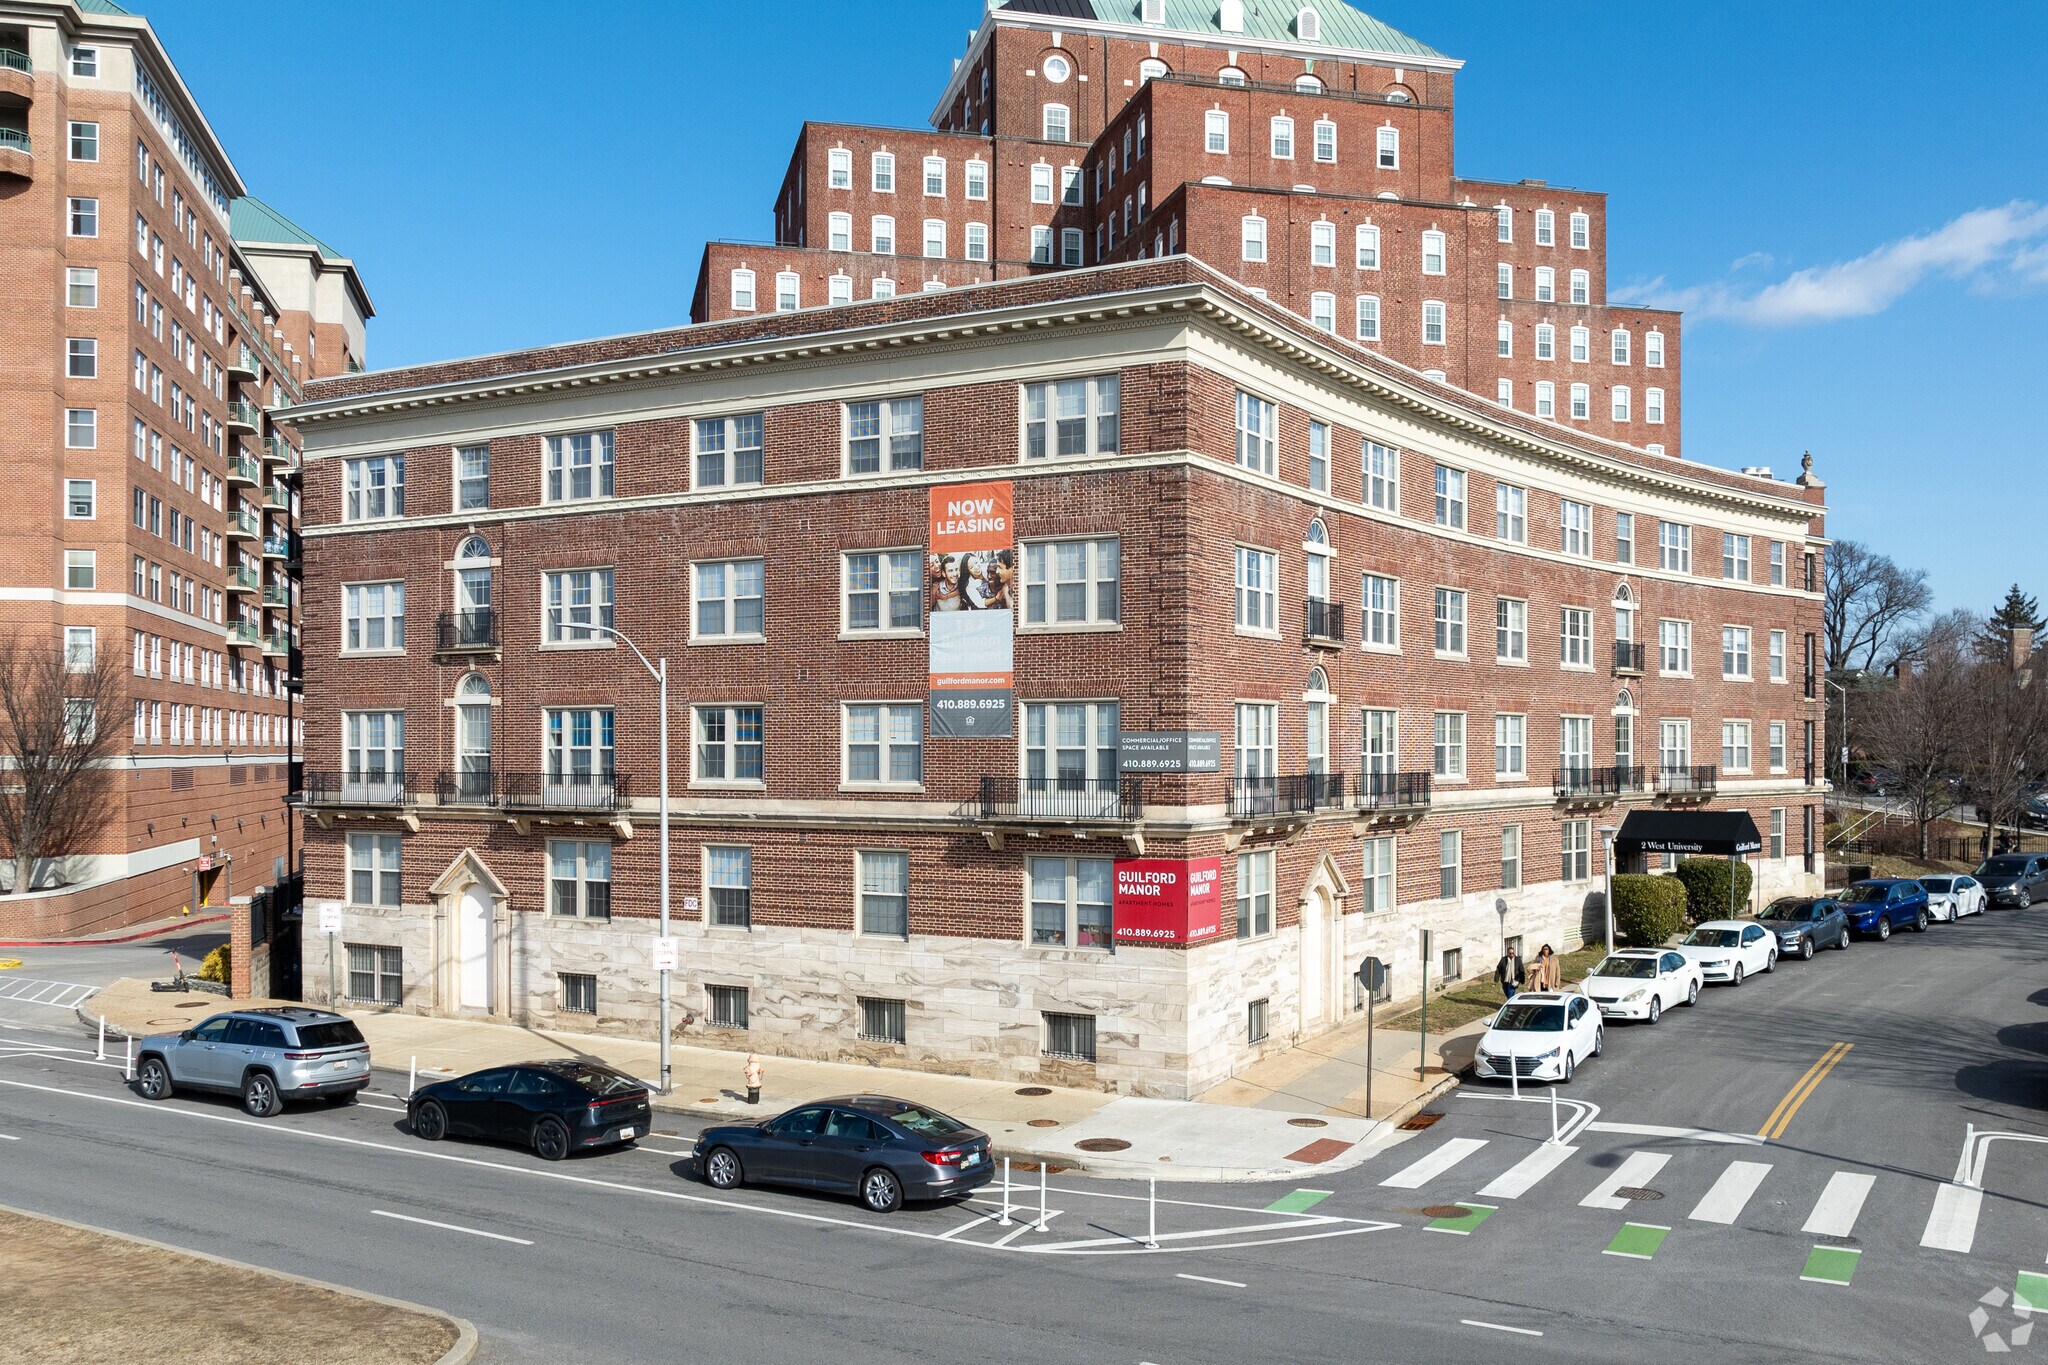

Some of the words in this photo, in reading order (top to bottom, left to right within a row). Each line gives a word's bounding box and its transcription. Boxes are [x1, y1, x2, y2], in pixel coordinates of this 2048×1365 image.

[948, 498, 994, 516] NOW
[937, 518, 1006, 535] LEASING
[936, 677, 1005, 686] guilfordmanor.com
[936, 700, 1006, 709] 410.889.6925
[1641, 841, 1646, 849] 2
[1647, 842, 1665, 850] West
[1668, 842, 1702, 852] University
[1118, 872, 1176, 884] GUILFORD
[1190, 870, 1216, 884] GUILFORD
[1118, 884, 1160, 896] MANOR
[1190, 883, 1210, 896] MANOR
[1117, 928, 1174, 938] 410.889.6925
